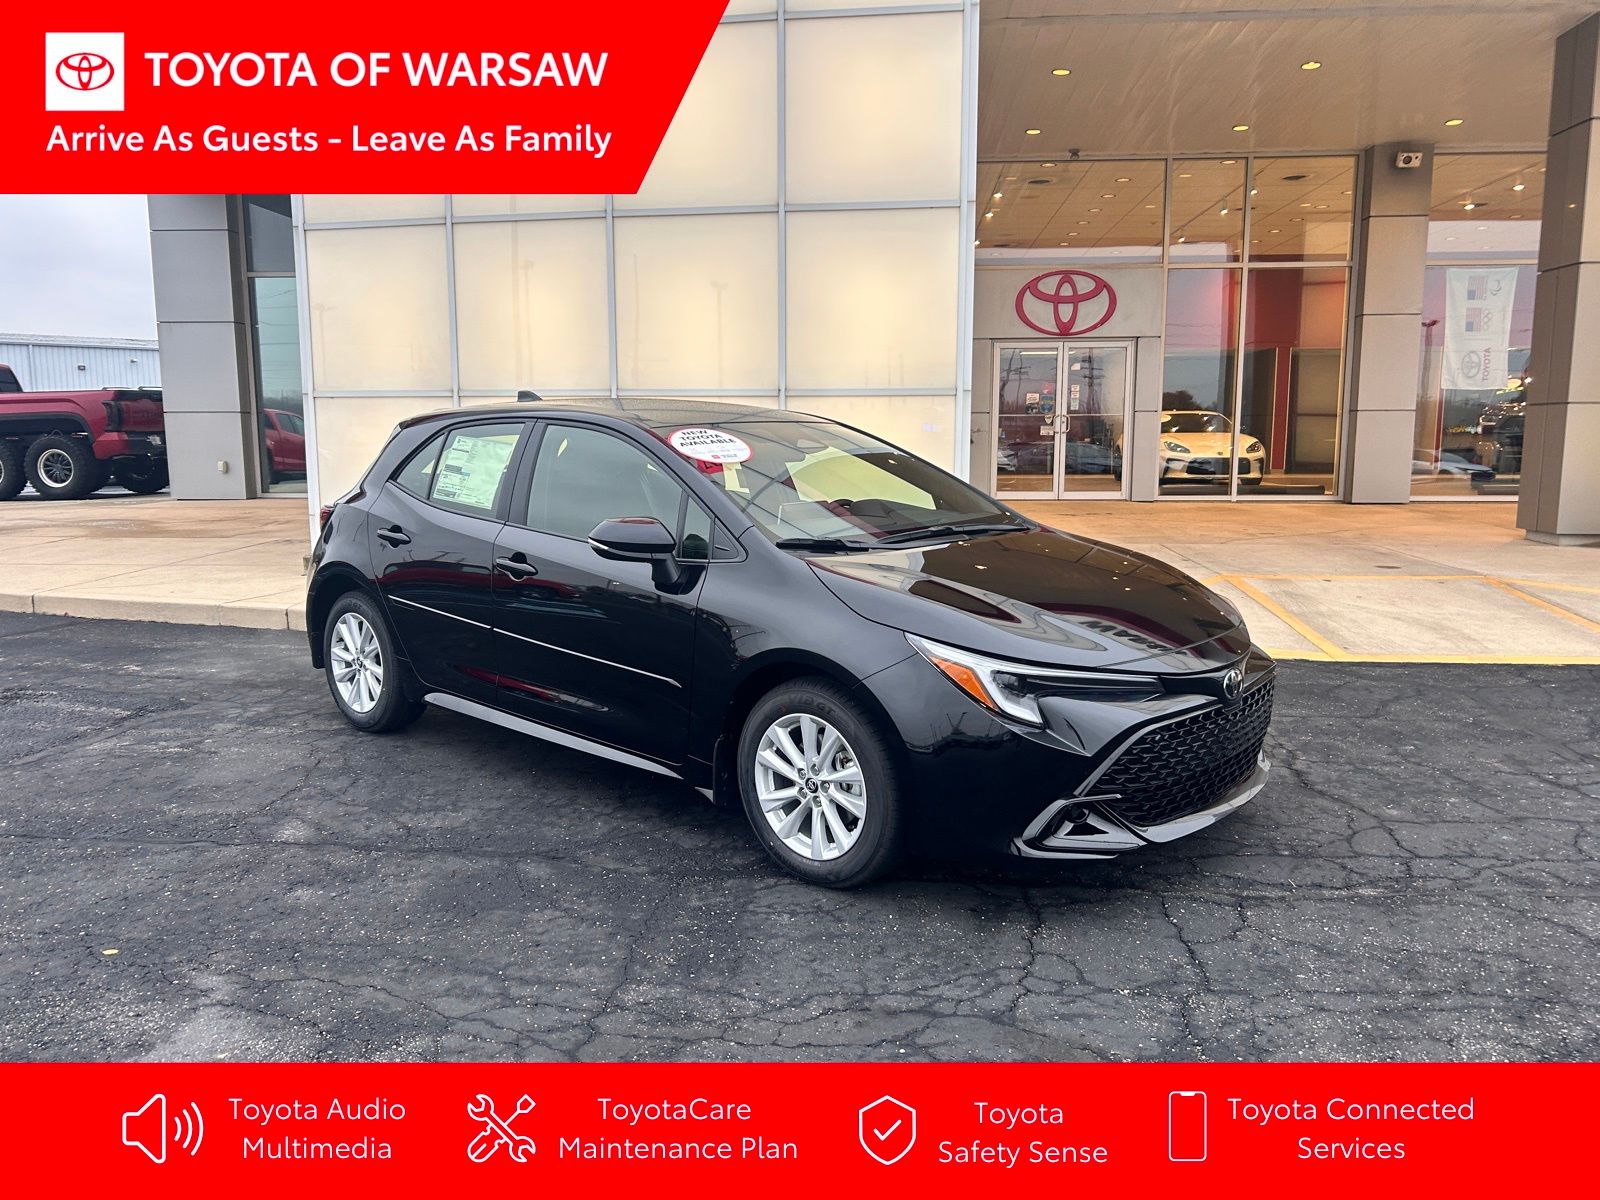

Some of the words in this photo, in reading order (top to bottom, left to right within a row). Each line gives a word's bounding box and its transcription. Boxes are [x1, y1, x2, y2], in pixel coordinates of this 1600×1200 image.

[1481, 347, 1492, 382] TOYOTA
[680, 433, 722, 441] TOYOTA
[680, 438, 736, 447] AVAILABLE
